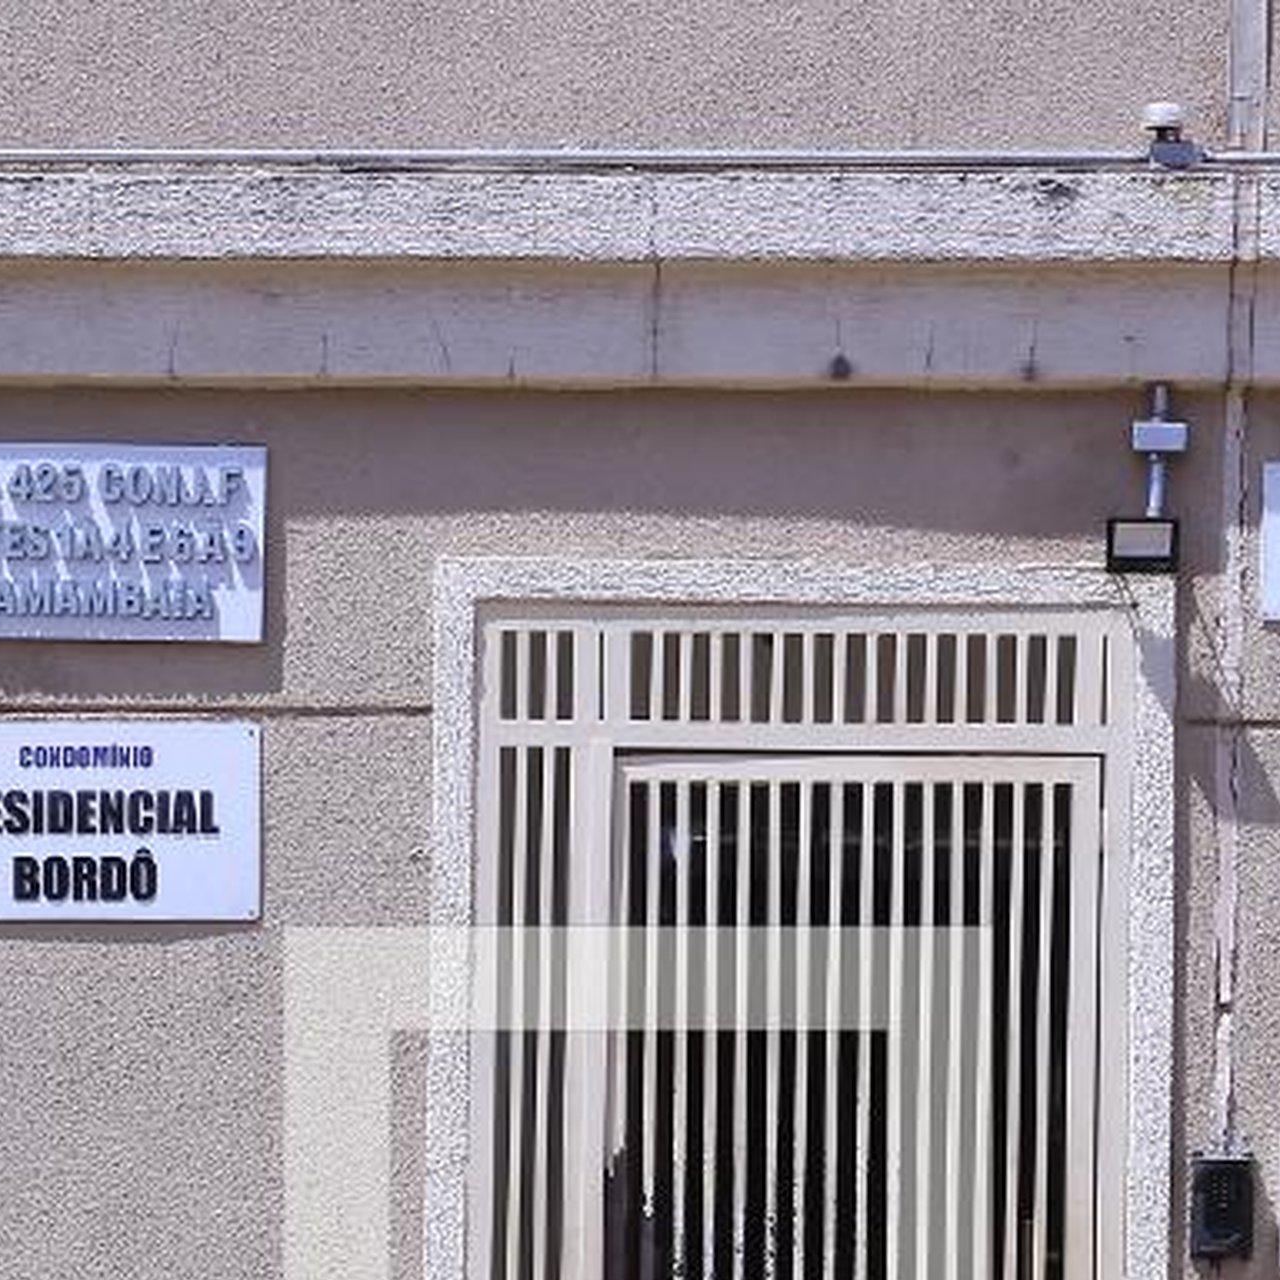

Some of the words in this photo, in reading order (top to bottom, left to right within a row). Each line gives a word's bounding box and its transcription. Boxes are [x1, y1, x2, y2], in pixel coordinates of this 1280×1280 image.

[8, 462, 87, 504] 425
[19, 743, 154, 768] CONDOMÍNIO
[11, 847, 159, 903] BORDÔ
